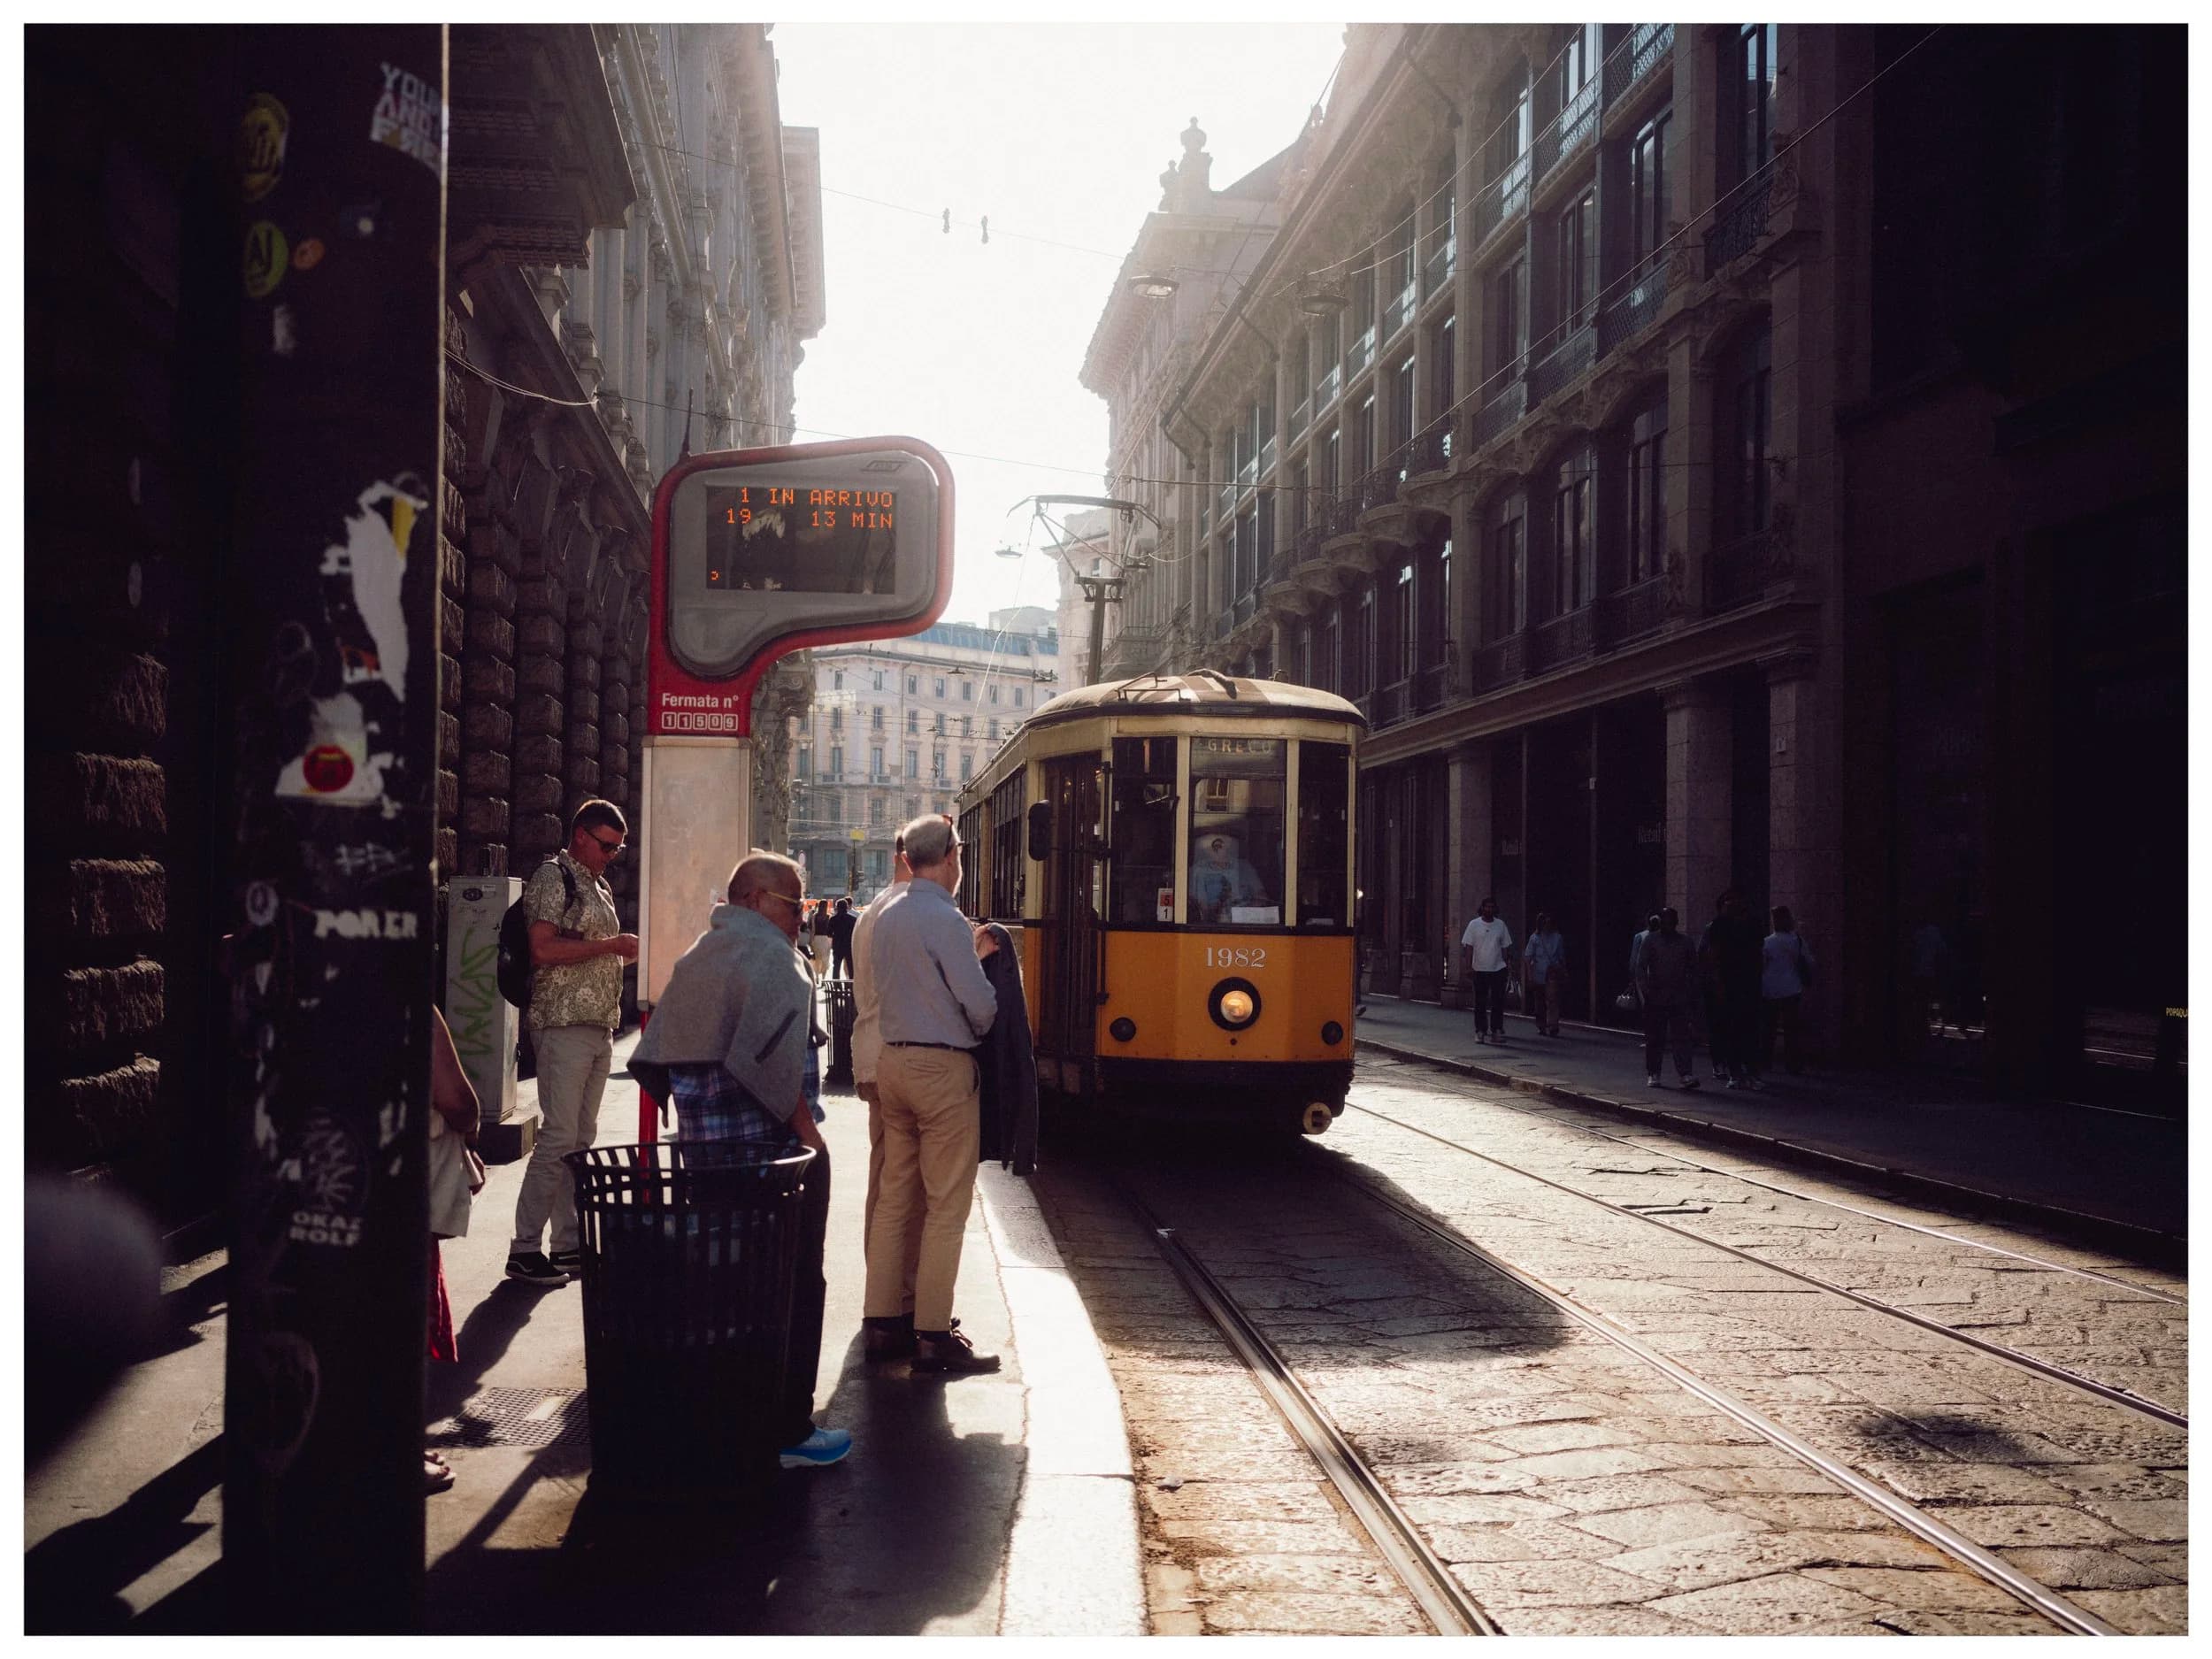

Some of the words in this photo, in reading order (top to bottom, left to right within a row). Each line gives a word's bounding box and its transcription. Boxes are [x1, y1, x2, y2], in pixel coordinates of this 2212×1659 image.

[741, 487, 749, 503] 1
[769, 488, 794, 505] IN
[810, 489, 893, 508] ARRIVO
[726, 508, 751, 524] 19
[811, 510, 836, 527] 13
[852, 512, 893, 529] MIN
[662, 692, 719, 708] Fermata
[664, 713, 736, 730] 11509
[1206, 947, 1267, 968] 1982
